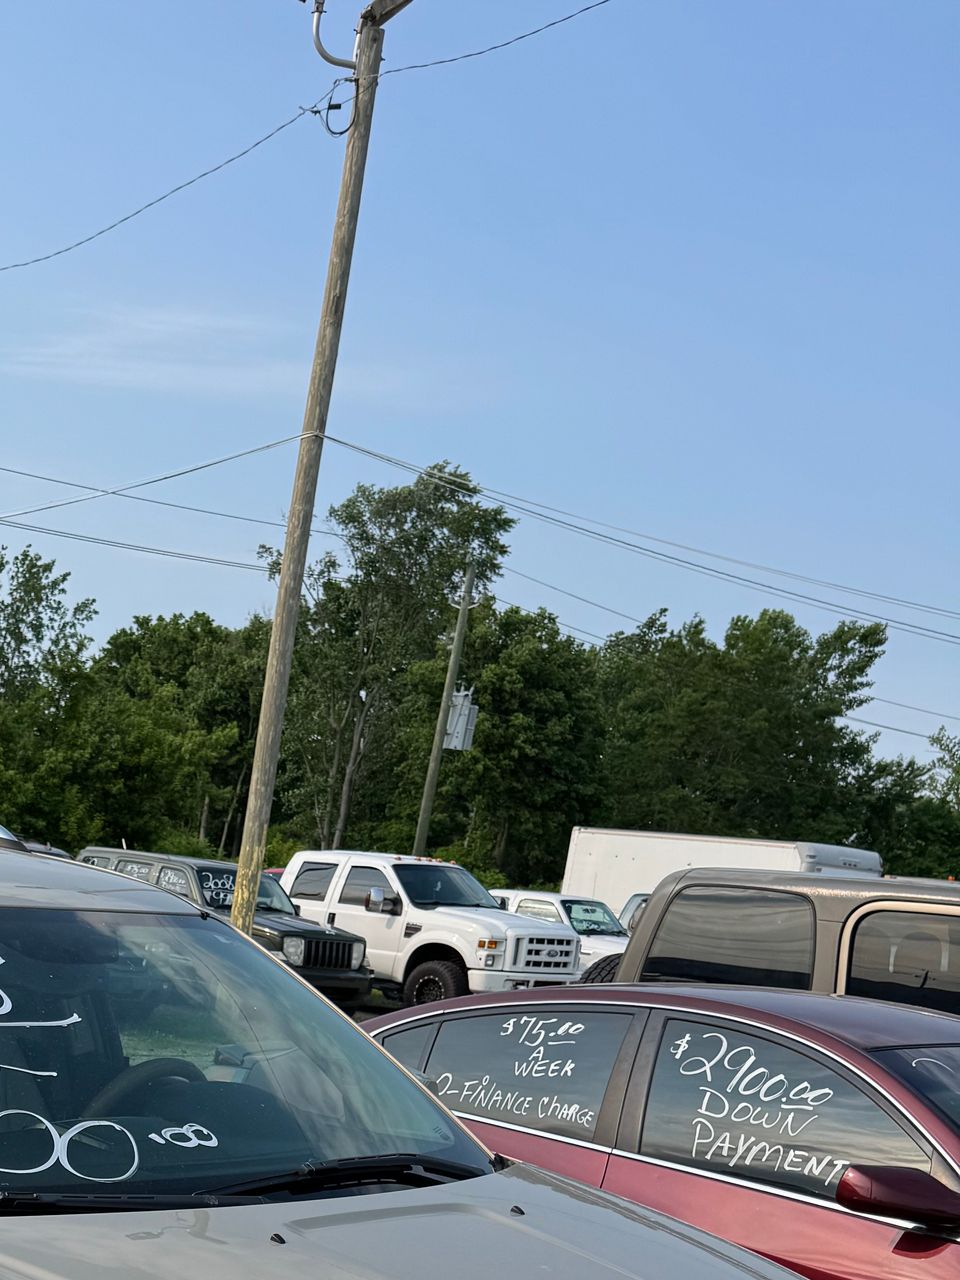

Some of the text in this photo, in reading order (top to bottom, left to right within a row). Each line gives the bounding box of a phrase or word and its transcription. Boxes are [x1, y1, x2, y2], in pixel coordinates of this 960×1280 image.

[500, 1016, 585, 1047] $75.00
[514, 1059, 576, 1078] WEEK
[528, 1046, 544, 1061] A
[670, 1033, 834, 1106] $2900.00
[692, 1118, 851, 1187] PAYMENT
